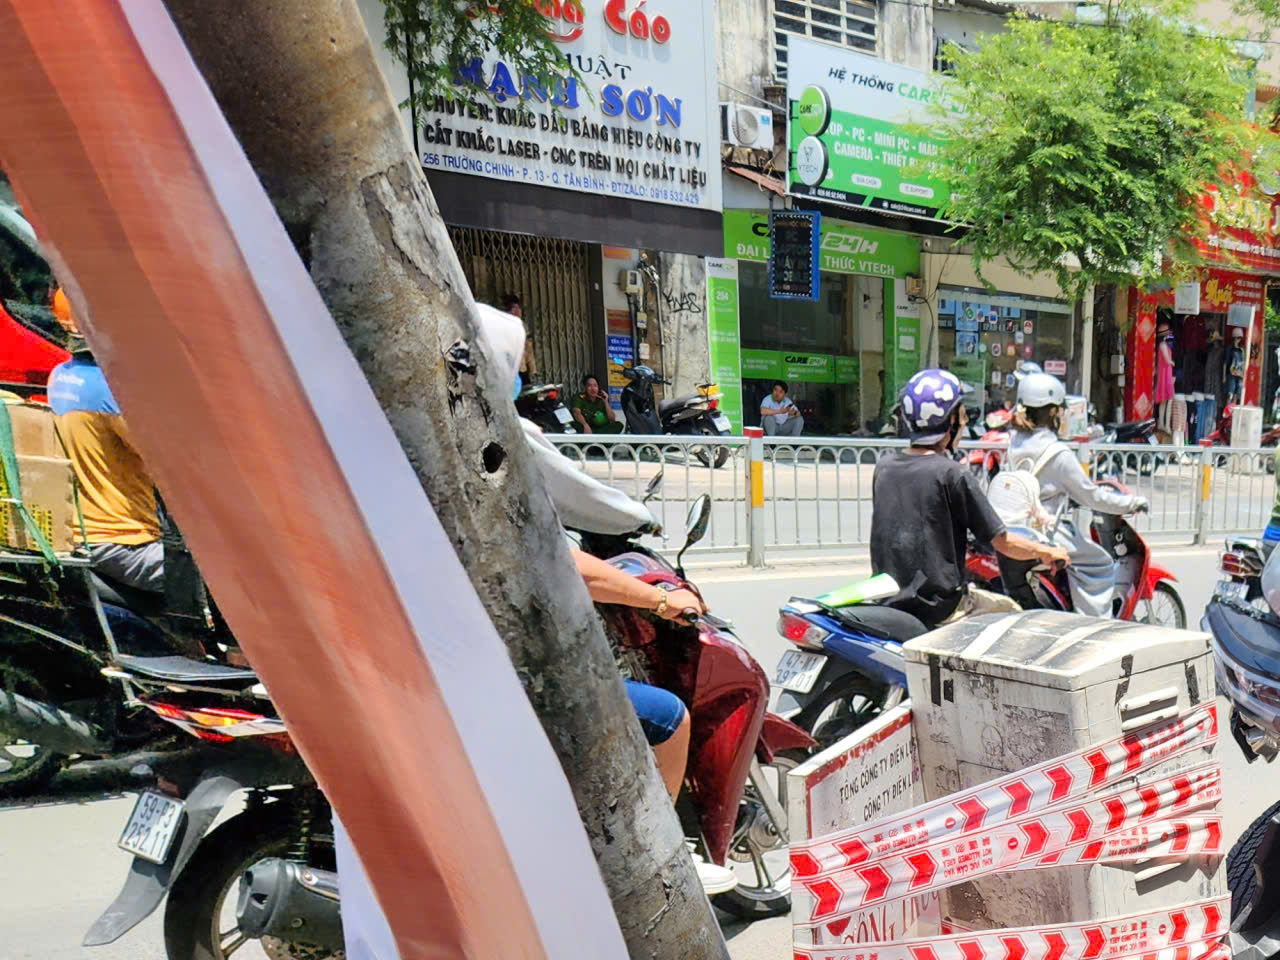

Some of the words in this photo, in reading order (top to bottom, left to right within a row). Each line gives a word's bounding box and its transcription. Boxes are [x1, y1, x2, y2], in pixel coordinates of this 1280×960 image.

[828, 67, 847, 85] HỆ
[851, 73, 894, 93] THỐNG
[600, 82, 684, 129] SƠN
[424, 118, 453, 146] CẮT
[456, 125, 495, 155] KHẮC
[498, 137, 541, 161] LASER
[551, 146, 576, 167] CNC
[579, 150, 612, 173] TRÊN
[616, 157, 639, 180] MỌI
[643, 159, 676, 182] CHẤT
[679, 166, 707, 189] LIỆU
[572, 115, 609, 142] BẢNG
[611, 125, 643, 150] HIỆU
[646, 131, 682, 155] CÔNG
[684, 140, 702, 159] TY
[833, 141, 874, 161] CAMERA
[423, 152, 440, 166] 256
[443, 153, 483, 173] TRƯỜNG
[486, 162, 515, 178] CHINH
[535, 169, 545, 182] 13
[563, 172, 582, 187] TÂN
[583, 173, 606, 190] BÌNH
[736, 243, 759, 259] ĐẠI
[823, 251, 856, 271] THỨC
[859, 259, 896, 275] VTECH
[860, 765, 878, 789] CÔNG
[879, 757, 889, 772] TY
[863, 796, 881, 822] CÔNG
[882, 787, 890, 806] TY
